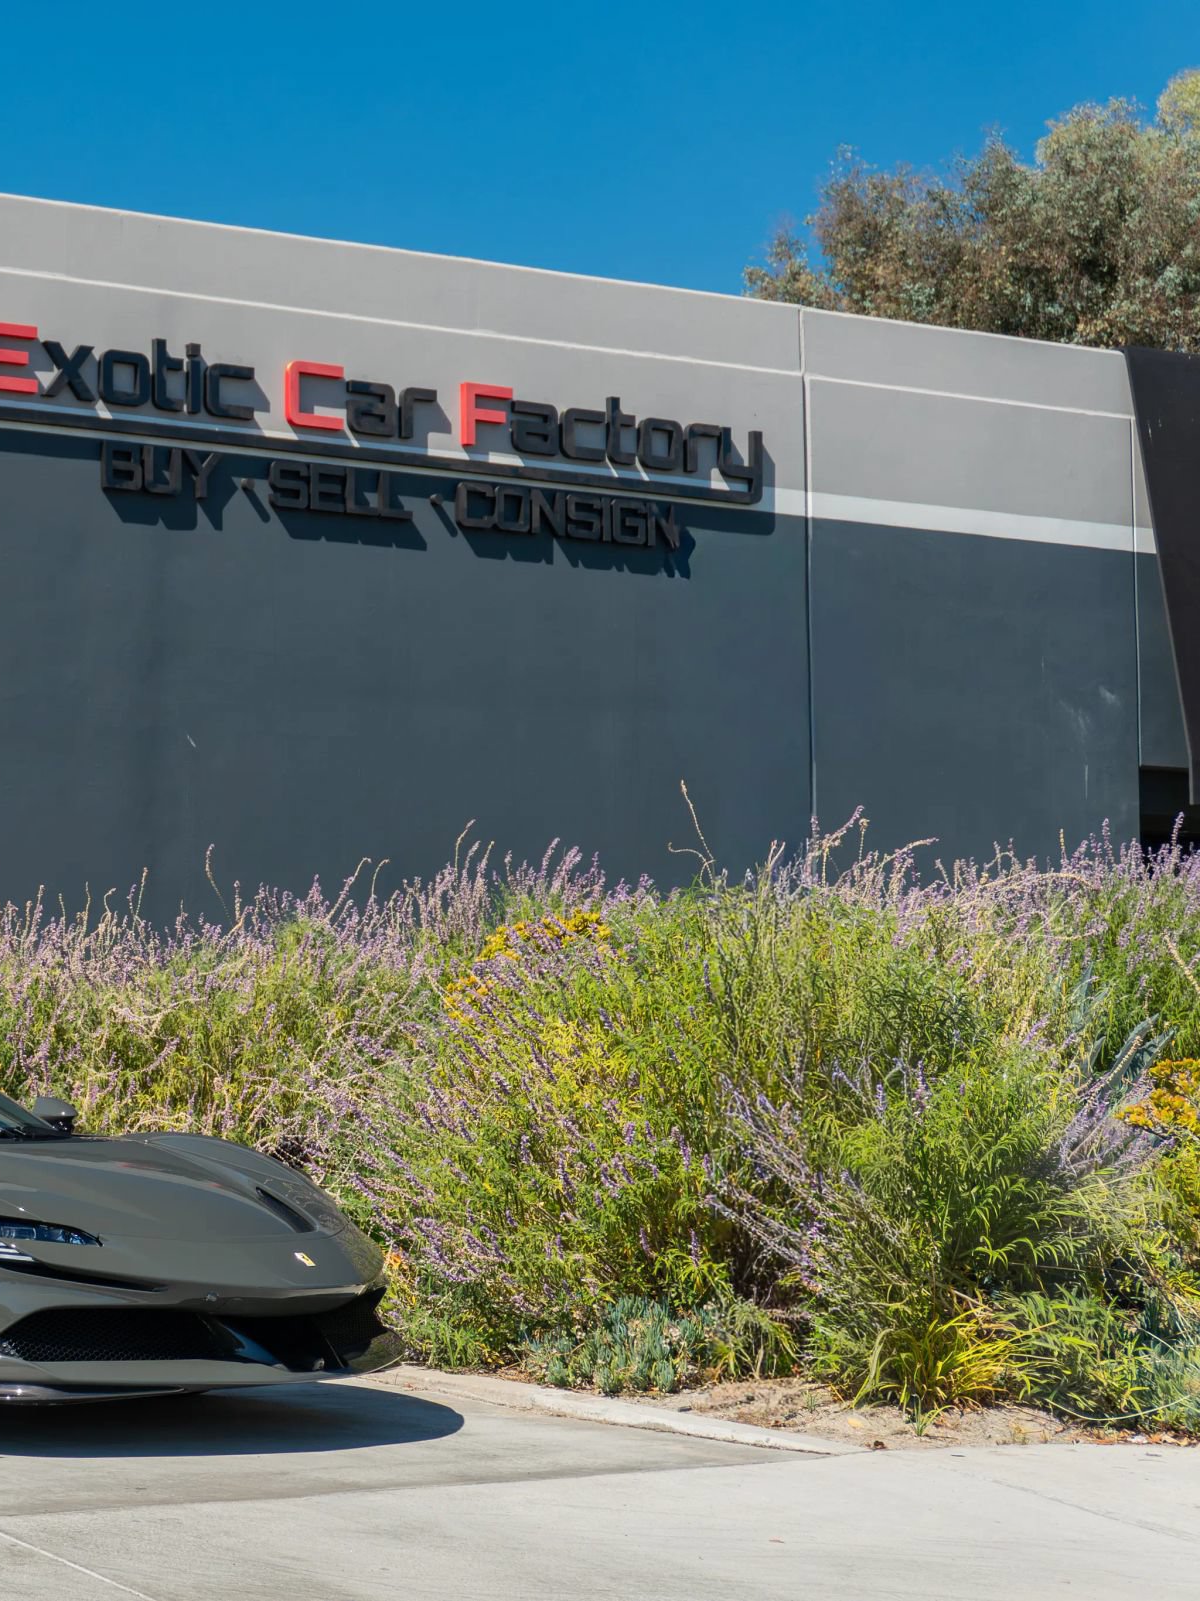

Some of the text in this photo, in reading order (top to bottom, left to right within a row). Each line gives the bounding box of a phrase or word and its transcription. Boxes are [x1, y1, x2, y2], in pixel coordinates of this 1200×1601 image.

[102, 440, 680, 549] BUY SELL CONSIGN
[285, 360, 437, 439] Car
[460, 381, 763, 505] Factory
